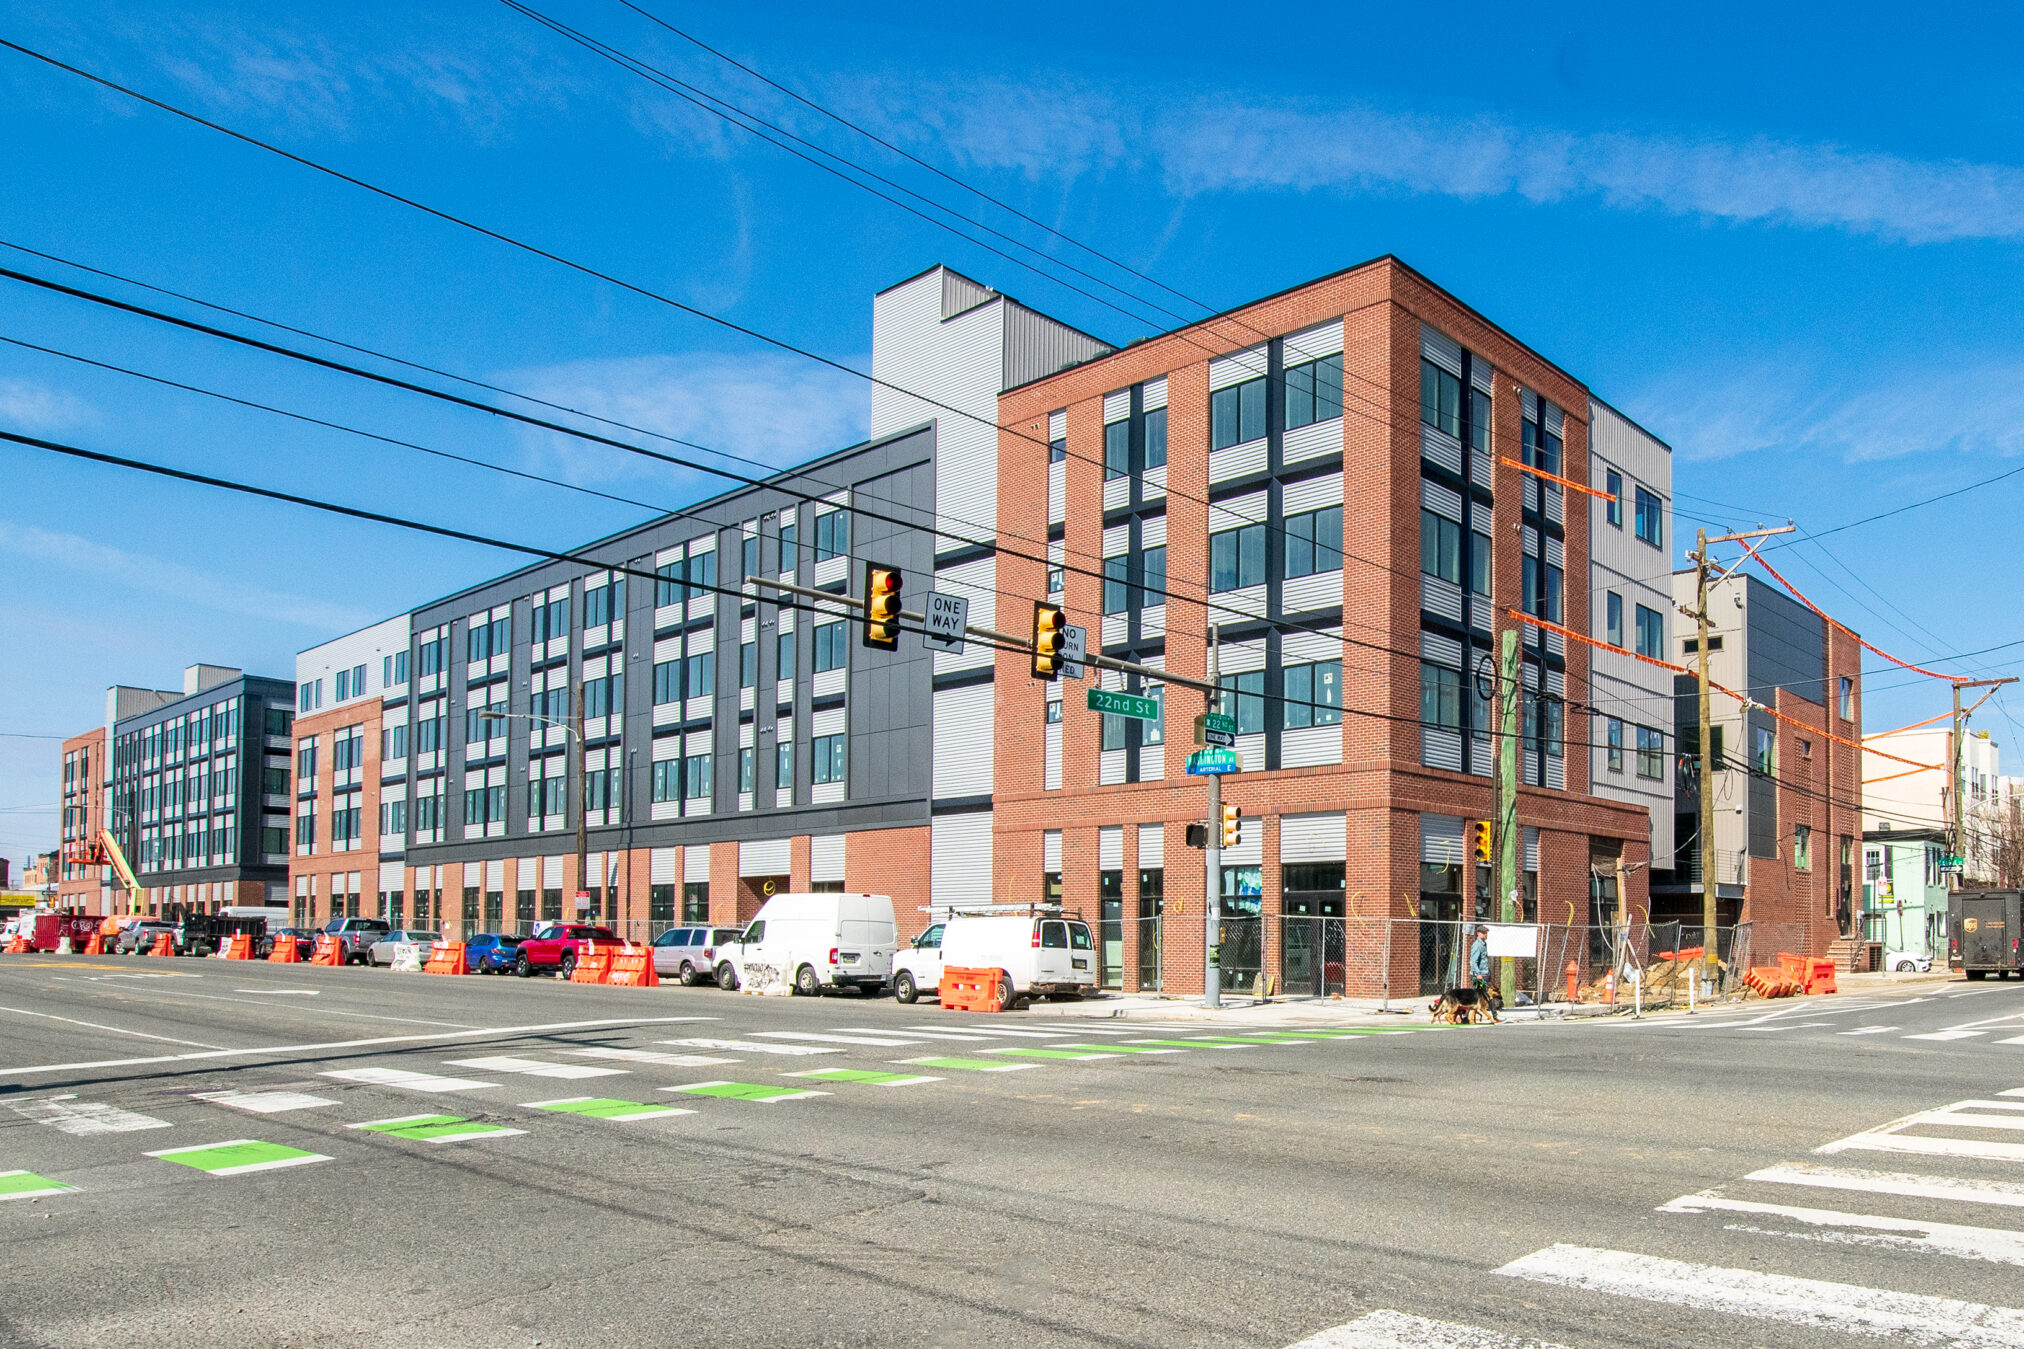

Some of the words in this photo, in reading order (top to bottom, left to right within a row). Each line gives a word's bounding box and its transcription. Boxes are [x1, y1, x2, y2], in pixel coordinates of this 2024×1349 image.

[934, 598, 961, 615] ONE
[932, 614, 960, 630] WAY
[1062, 628, 1076, 639] NO
[1063, 641, 1079, 651] URN
[1063, 653, 1074, 662] ON
[1096, 694, 1130, 711] 22nd
[1136, 701, 1150, 715] St
[1227, 764, 1232, 772] E
